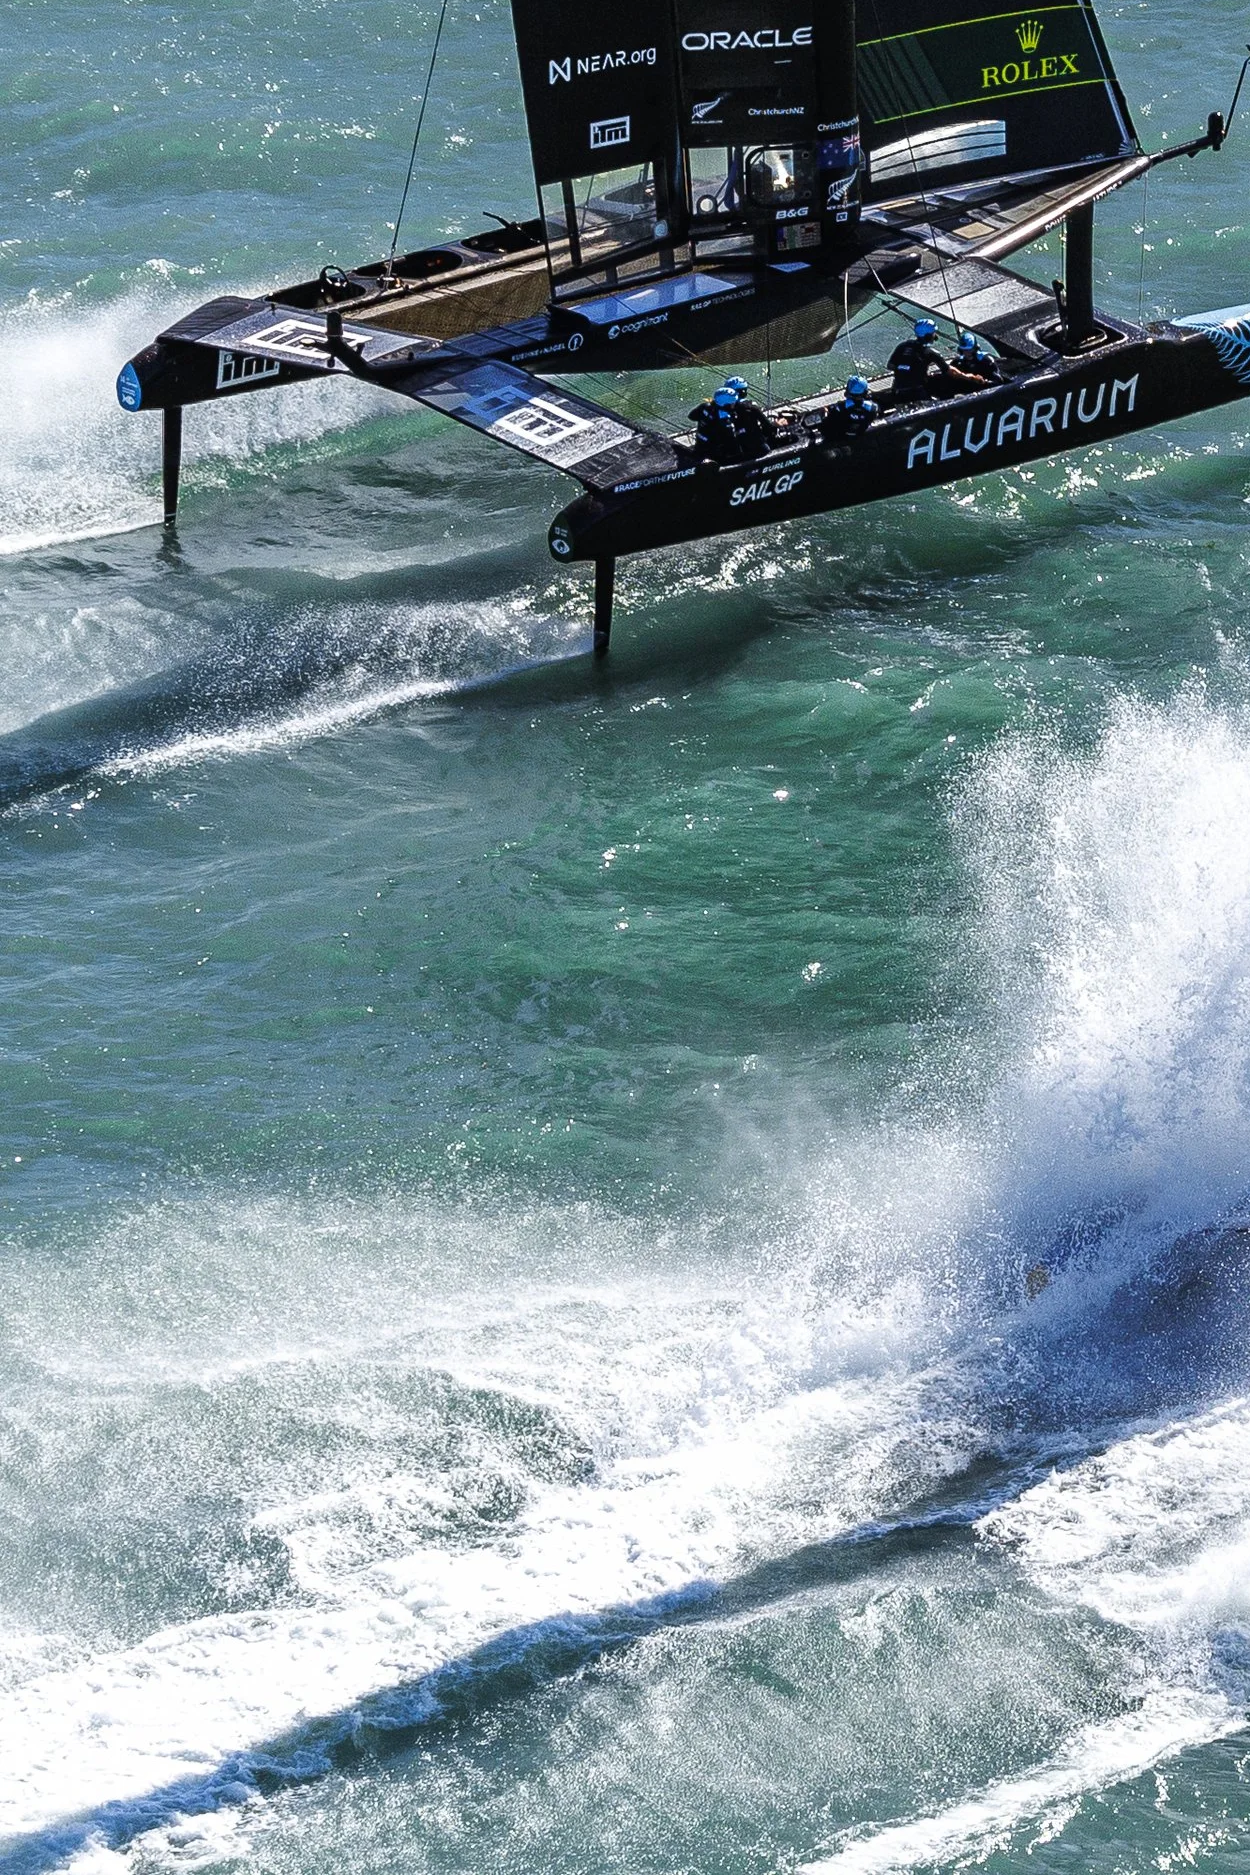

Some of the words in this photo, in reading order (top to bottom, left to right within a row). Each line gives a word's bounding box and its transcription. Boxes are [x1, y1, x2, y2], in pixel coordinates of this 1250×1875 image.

[682, 26, 812, 51] ORACLE
[577, 47, 656, 75] NEAR.org
[981, 53, 1080, 88] ROLEX
[775, 207, 809, 220] B&G
